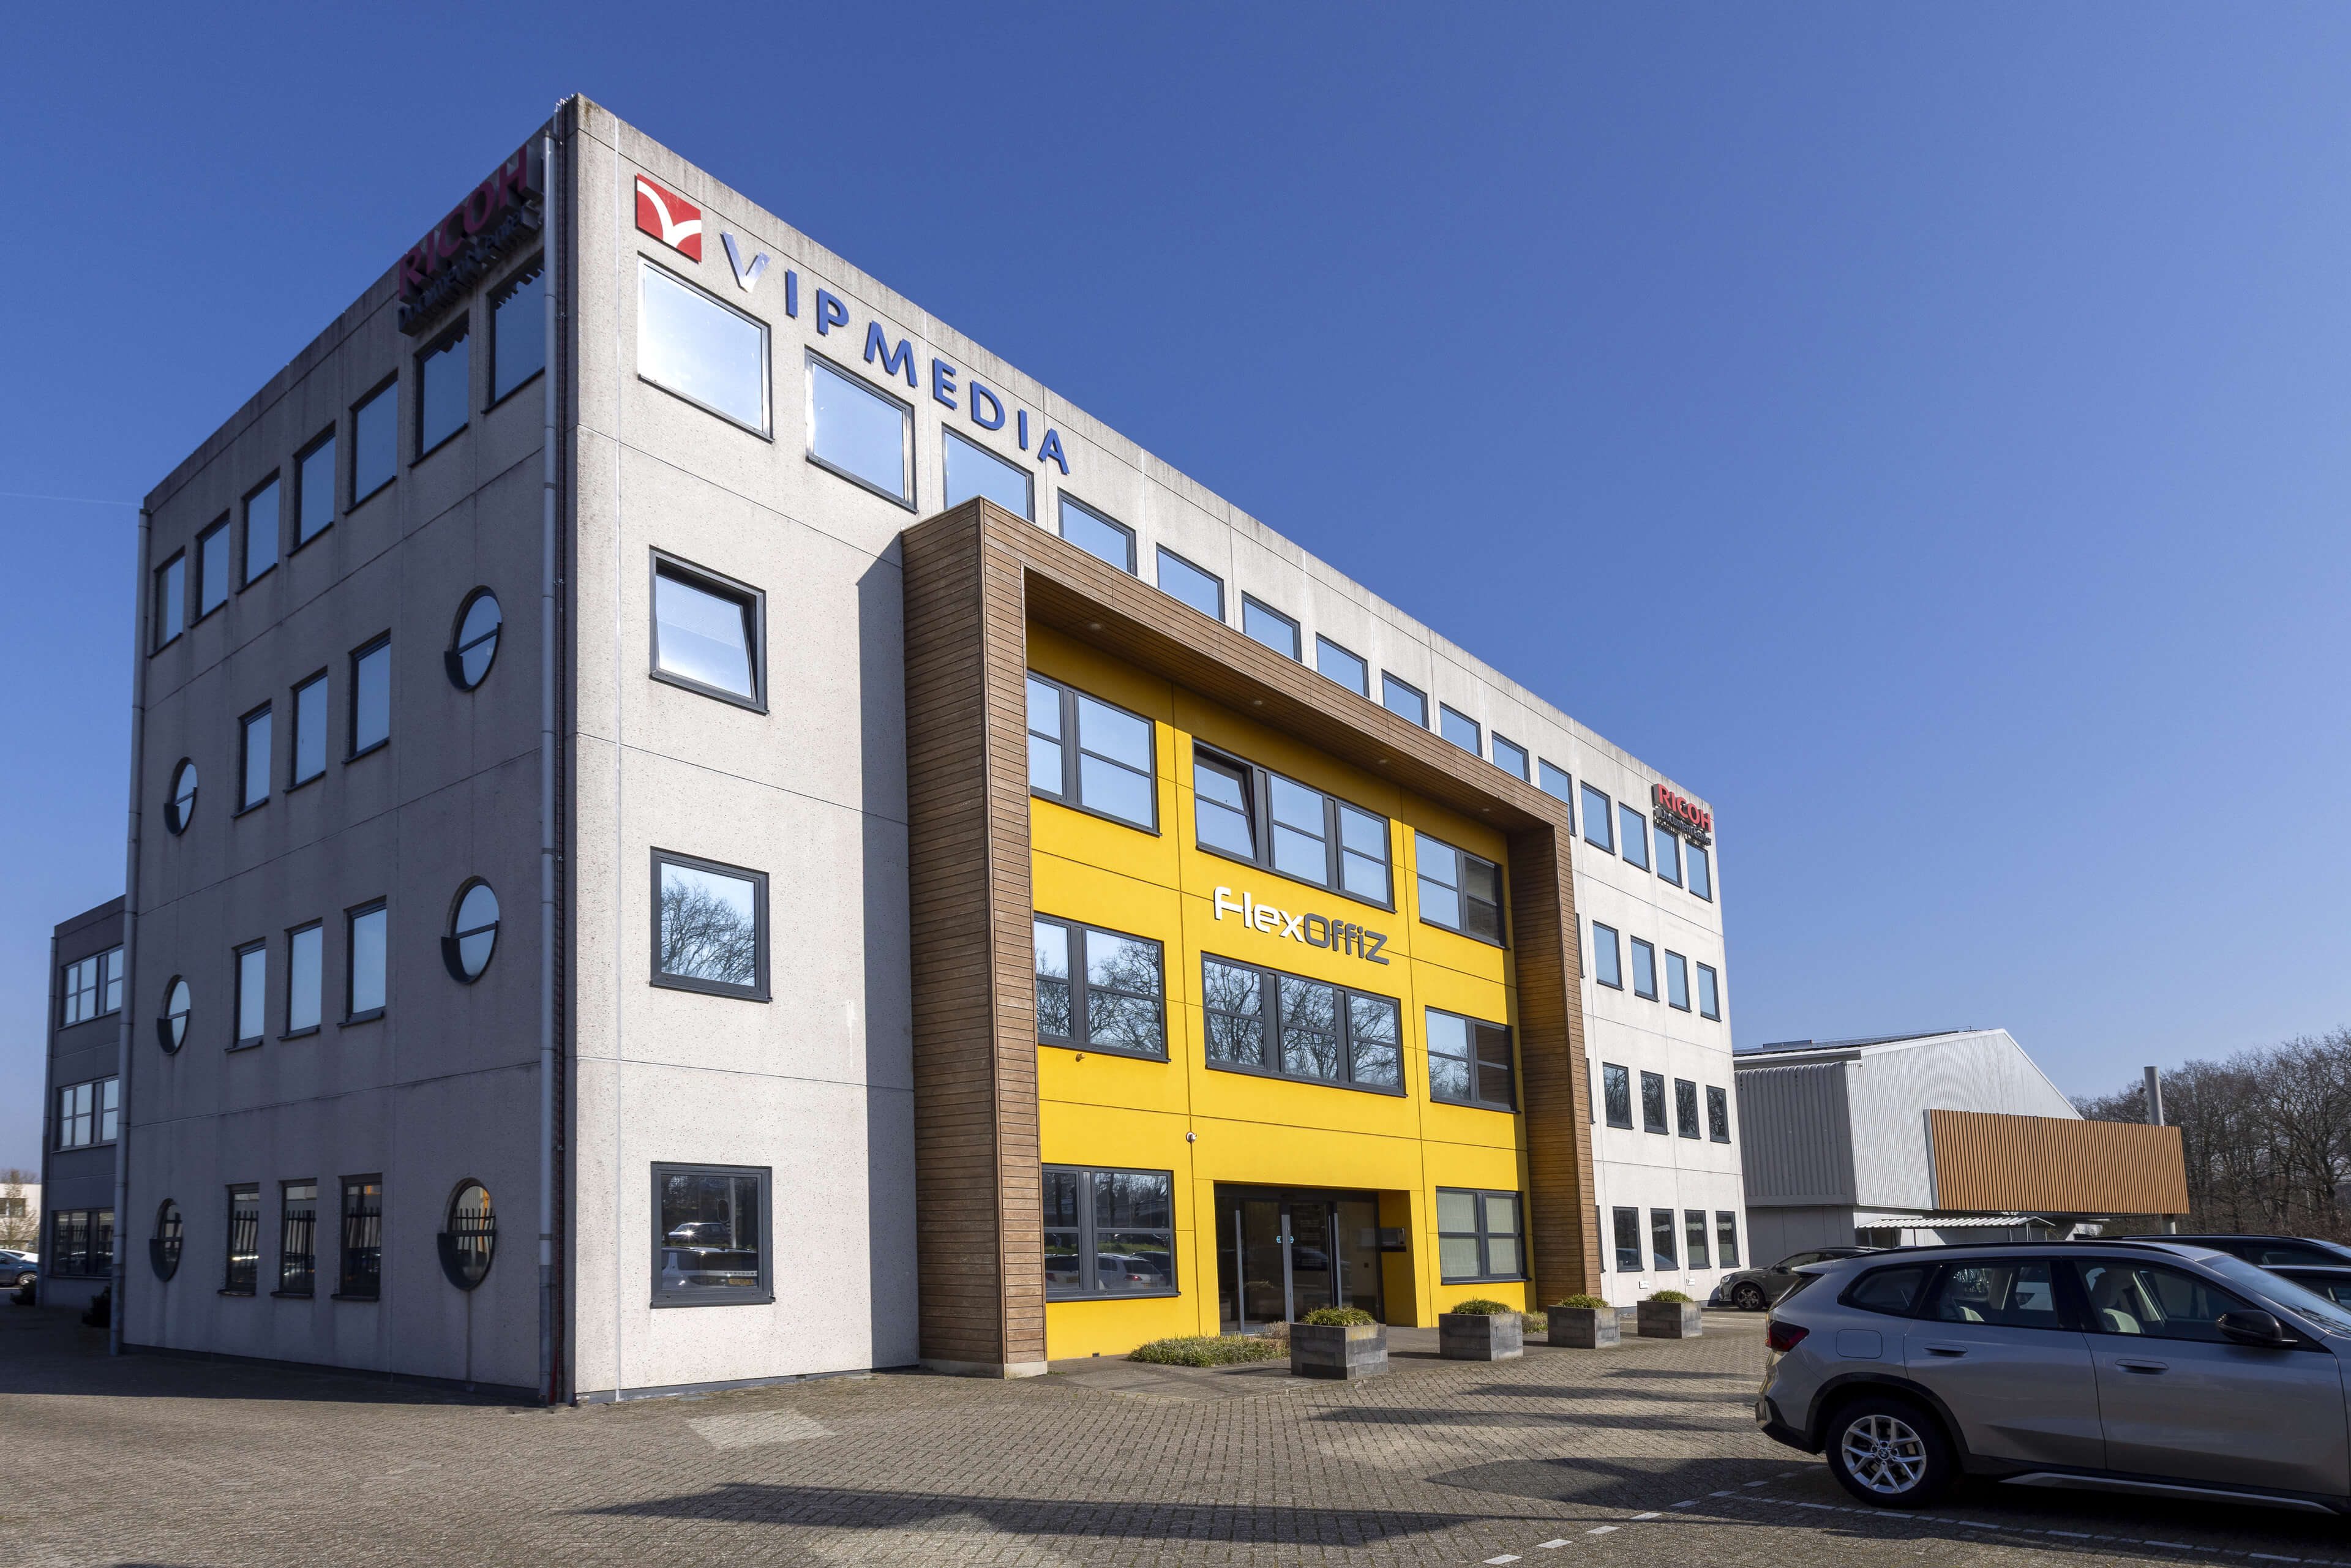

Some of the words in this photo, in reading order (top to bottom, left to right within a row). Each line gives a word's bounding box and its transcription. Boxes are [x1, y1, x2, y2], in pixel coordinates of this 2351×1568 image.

[399, 144, 527, 301] RICOH
[722, 230, 1070, 475] VIPMEDIA
[1658, 784, 1711, 833] RICOH
